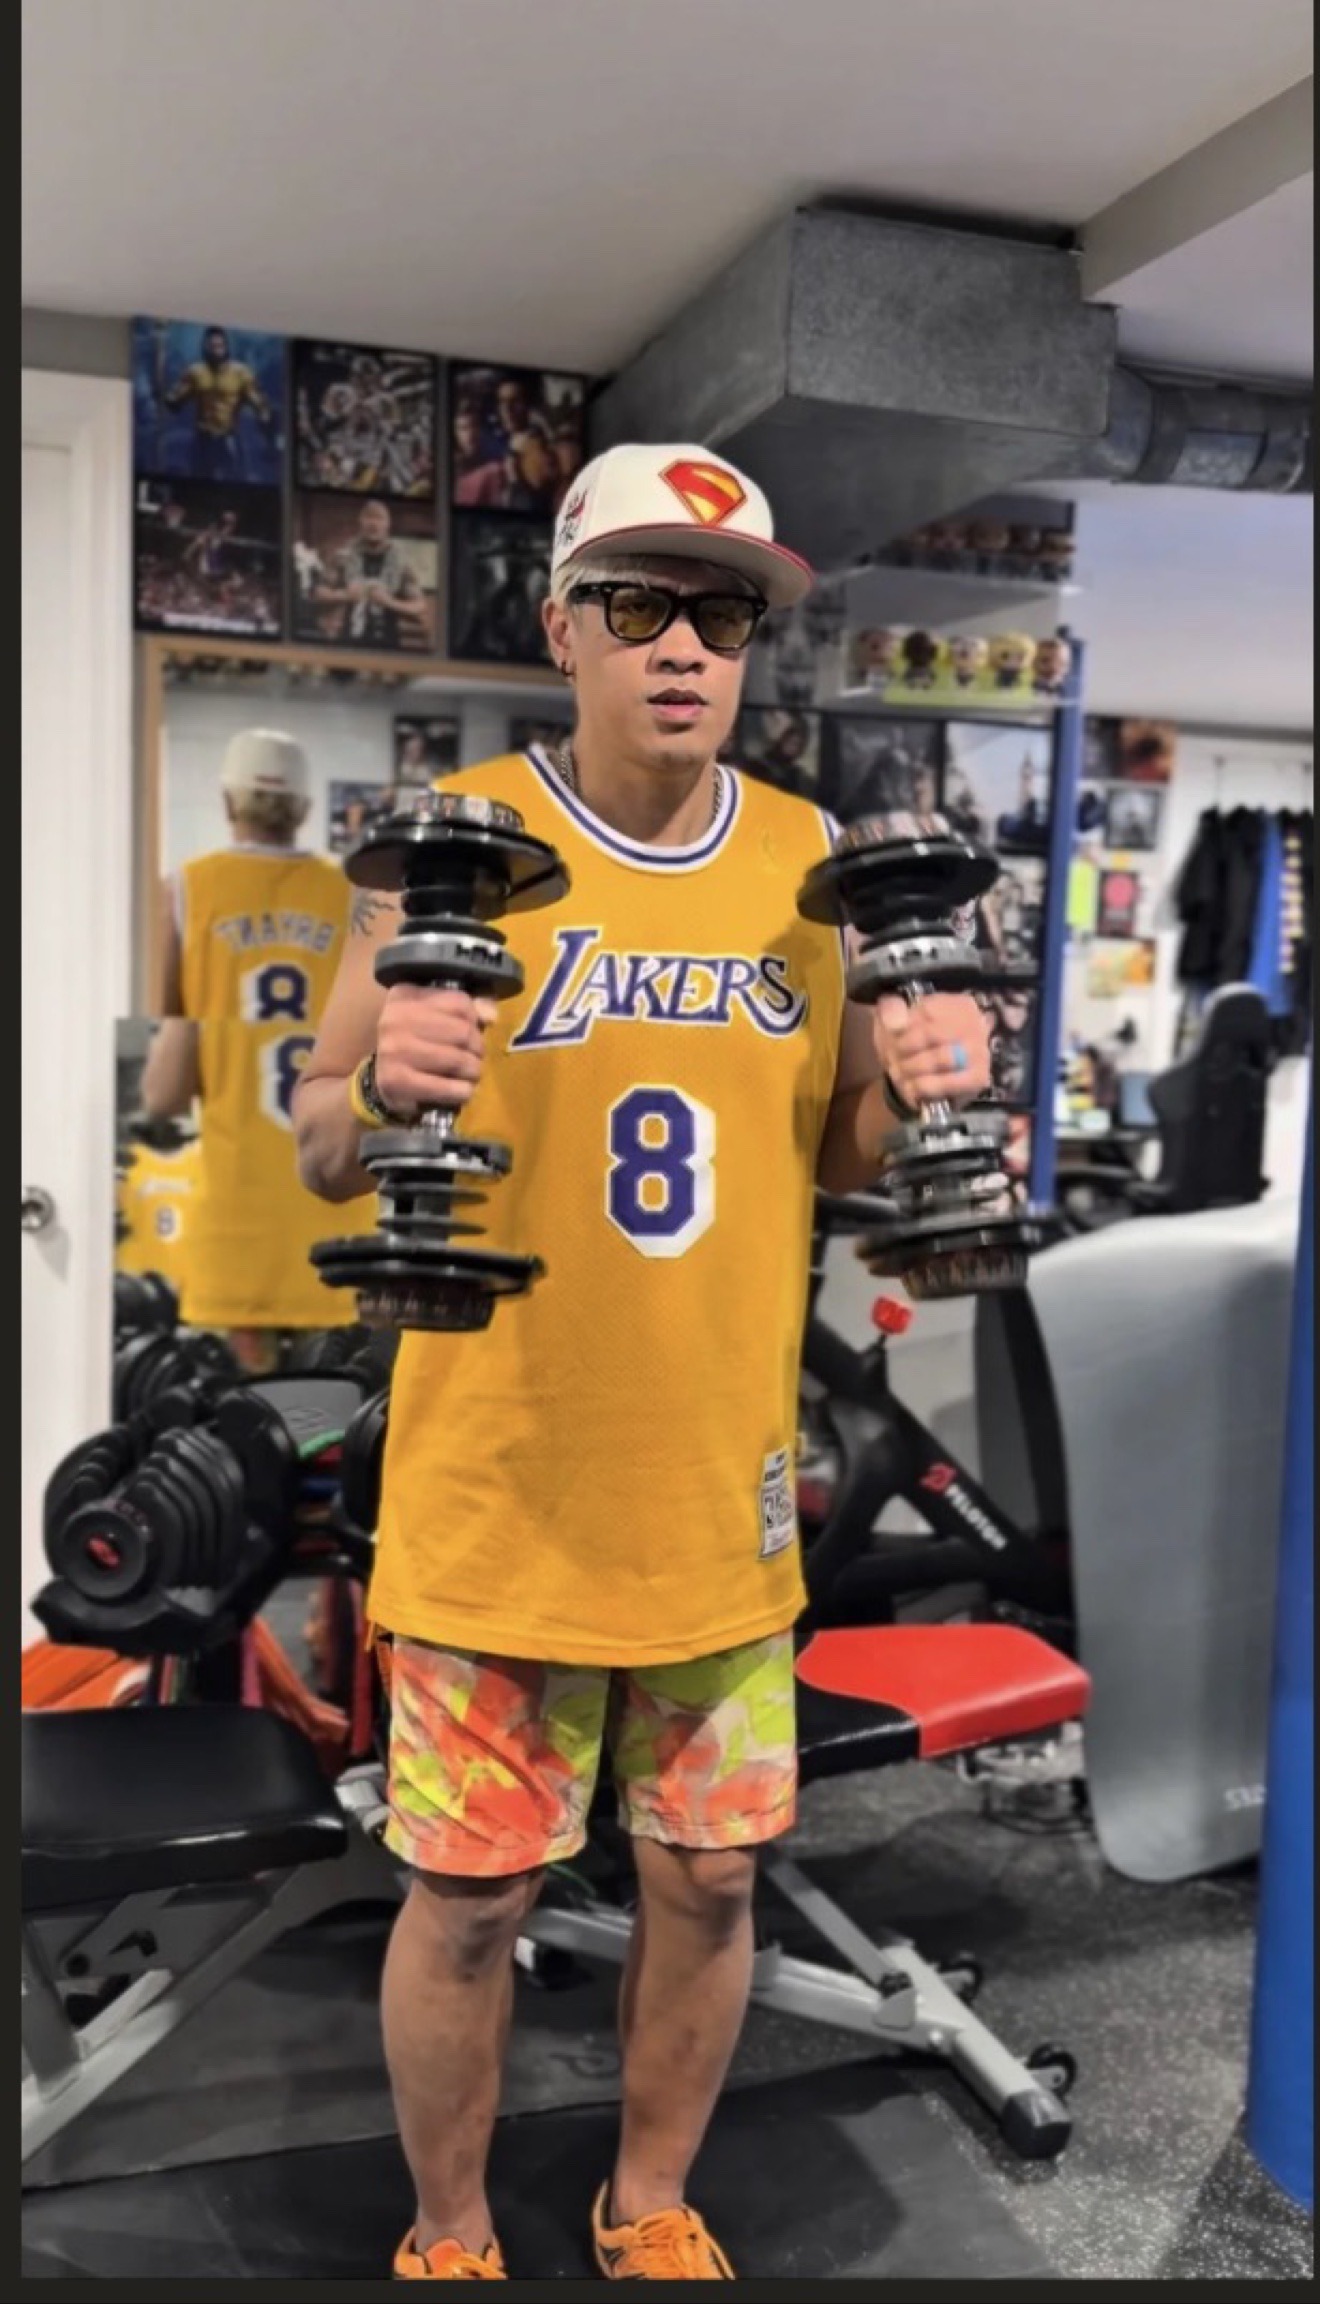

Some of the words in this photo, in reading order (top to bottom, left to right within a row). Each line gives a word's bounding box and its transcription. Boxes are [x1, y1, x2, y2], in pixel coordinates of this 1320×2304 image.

[510, 924, 809, 1050] LAKERS
[605, 1084, 716, 1258] 8
[945, 1484, 1007, 1549] PELOTON
